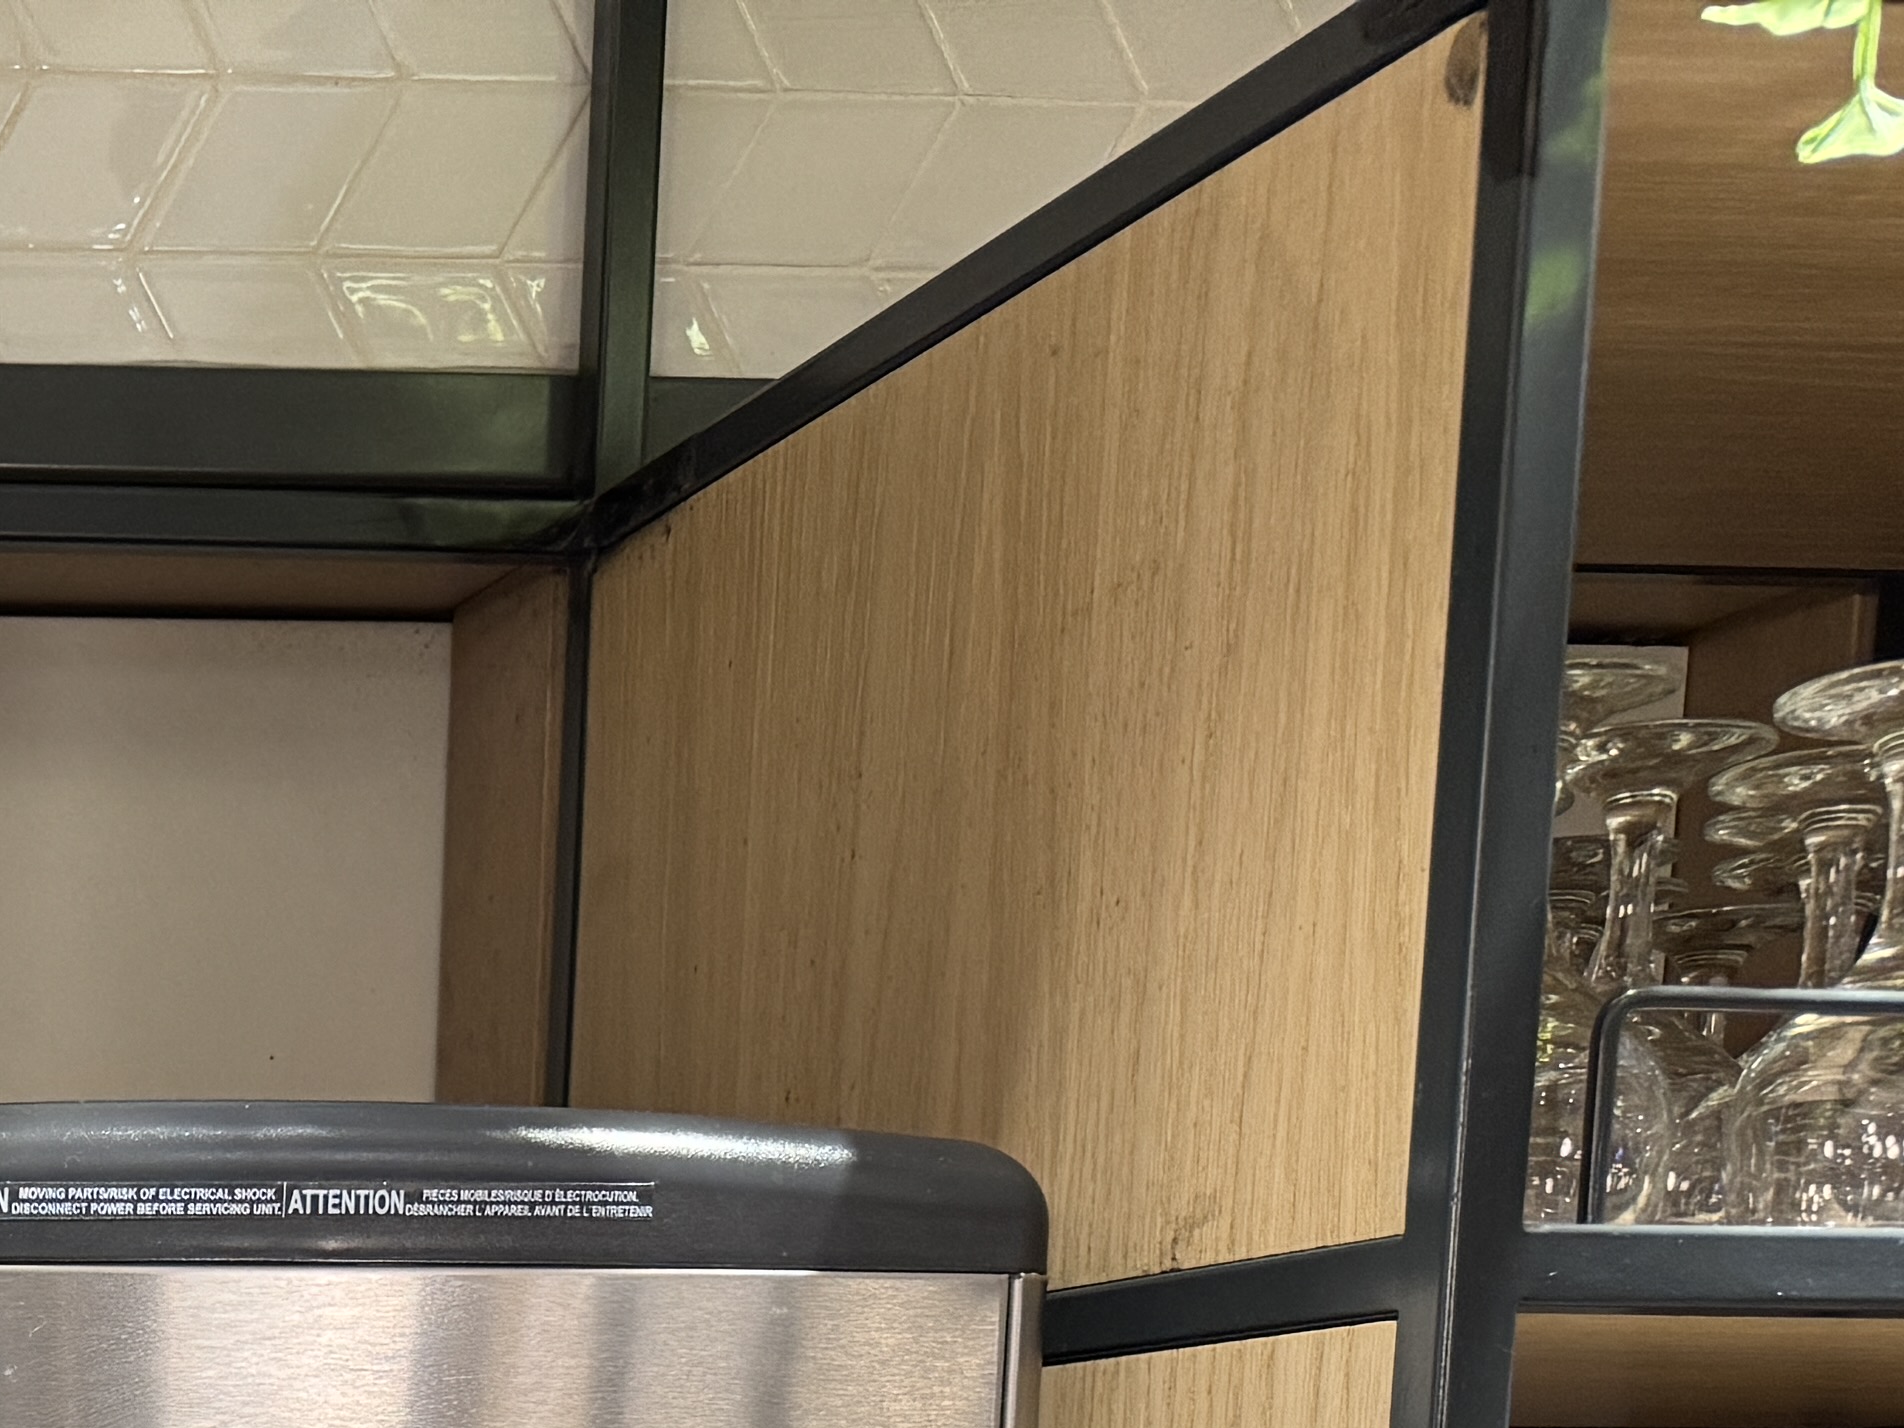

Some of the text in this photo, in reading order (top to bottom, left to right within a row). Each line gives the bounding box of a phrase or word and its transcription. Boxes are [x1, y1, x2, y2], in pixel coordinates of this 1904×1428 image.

[18, 1187, 66, 1200] MOVING
[139, 1187, 156, 1201] OF
[234, 1188, 276, 1201] SHOCK
[11, 1202, 87, 1216] DISCONNECT
[90, 1202, 134, 1216] POWER
[136, 1202, 185, 1216] BEFORE
[288, 1189, 405, 1215] ATTENTION
